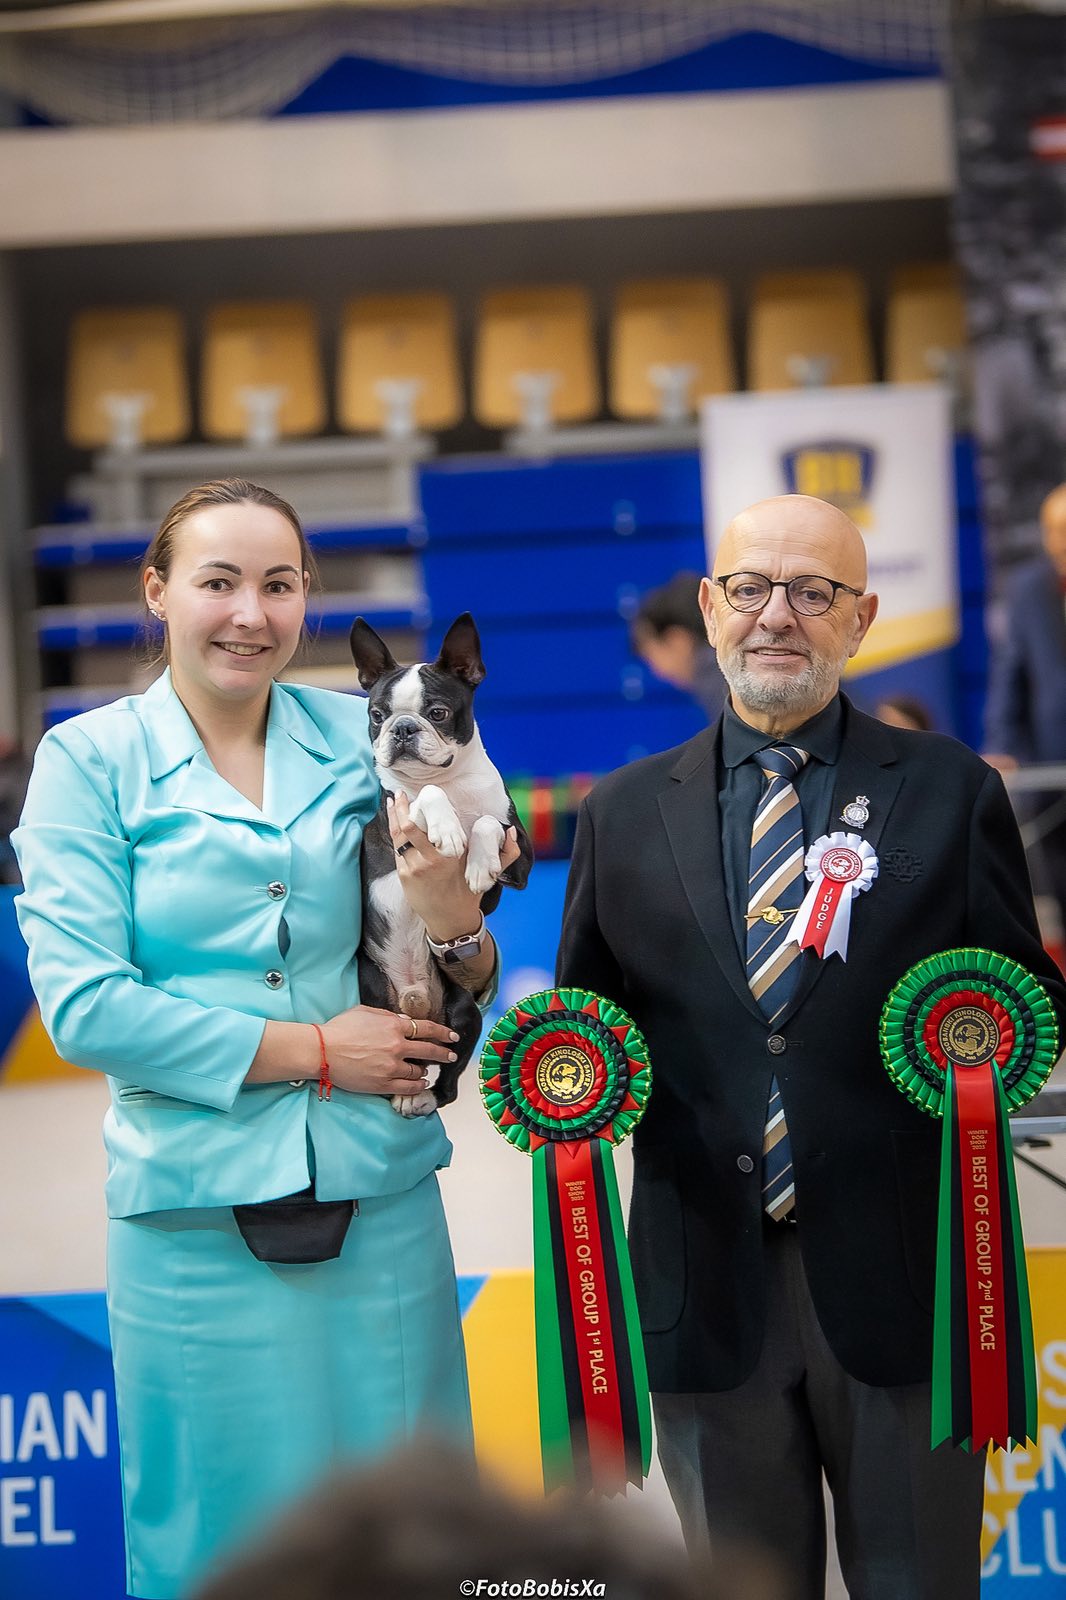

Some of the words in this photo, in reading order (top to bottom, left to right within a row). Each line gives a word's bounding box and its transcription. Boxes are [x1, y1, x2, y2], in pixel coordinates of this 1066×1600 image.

[816, 888, 833, 930] JUDGE
[971, 1156, 988, 1190] BEST
[571, 1206, 589, 1240] BEST
[973, 1194, 989, 1215] OF
[576, 1244, 593, 1266] OF
[975, 1220, 992, 1276] GROUP
[579, 1270, 600, 1325] GROUP
[977, 1280, 994, 1301] 2nd
[586, 1330, 602, 1345] 1st
[979, 1305, 996, 1351] PLACE
[588, 1349, 608, 1395] PLACE
[0, 1475, 76, 1546] EL
